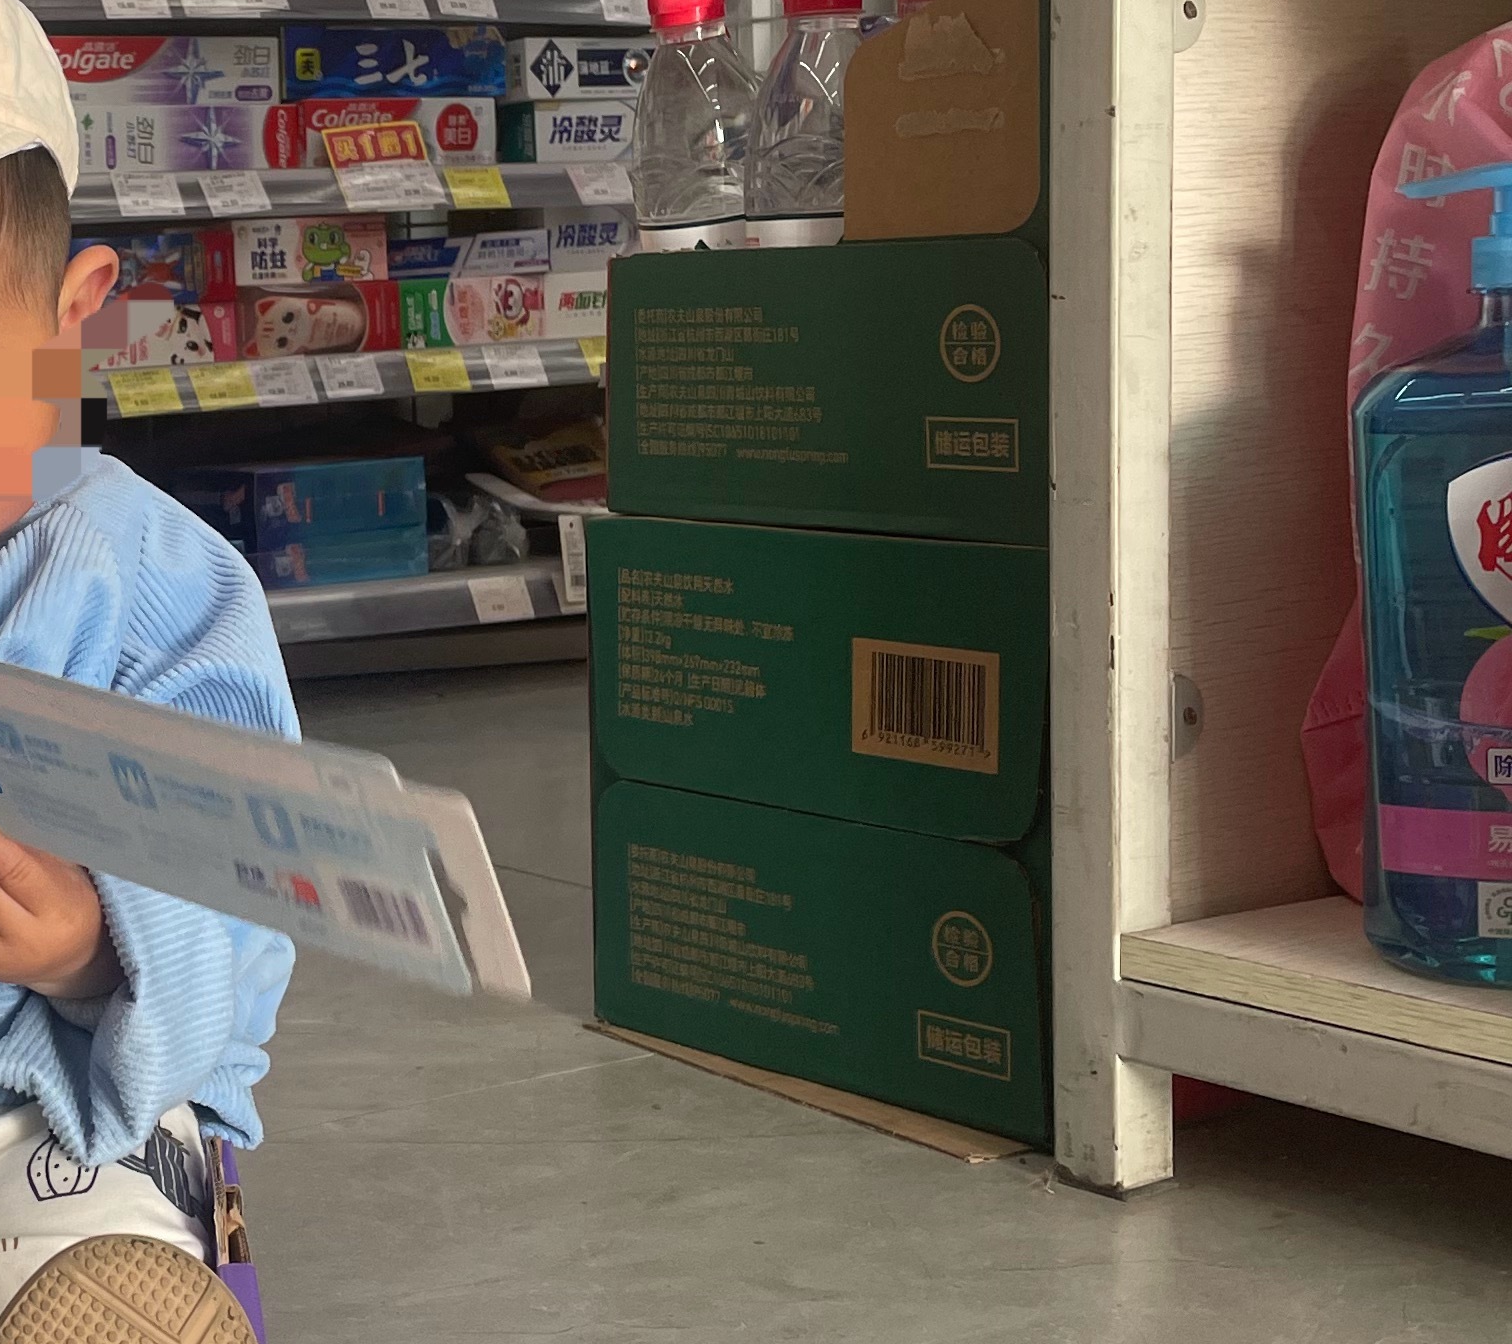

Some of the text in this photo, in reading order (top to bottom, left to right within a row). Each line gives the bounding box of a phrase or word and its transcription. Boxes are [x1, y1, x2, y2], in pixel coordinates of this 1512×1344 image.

[354, 39, 430, 89] 三七
[549, 114, 625, 146] 冷酸灵
[555, 221, 620, 250] 冷酸灵
[951, 321, 990, 341] 检验
[951, 348, 988, 368] 合格
[934, 430, 1011, 459] 储运包装
[925, 1024, 1005, 1067] 储运包装
